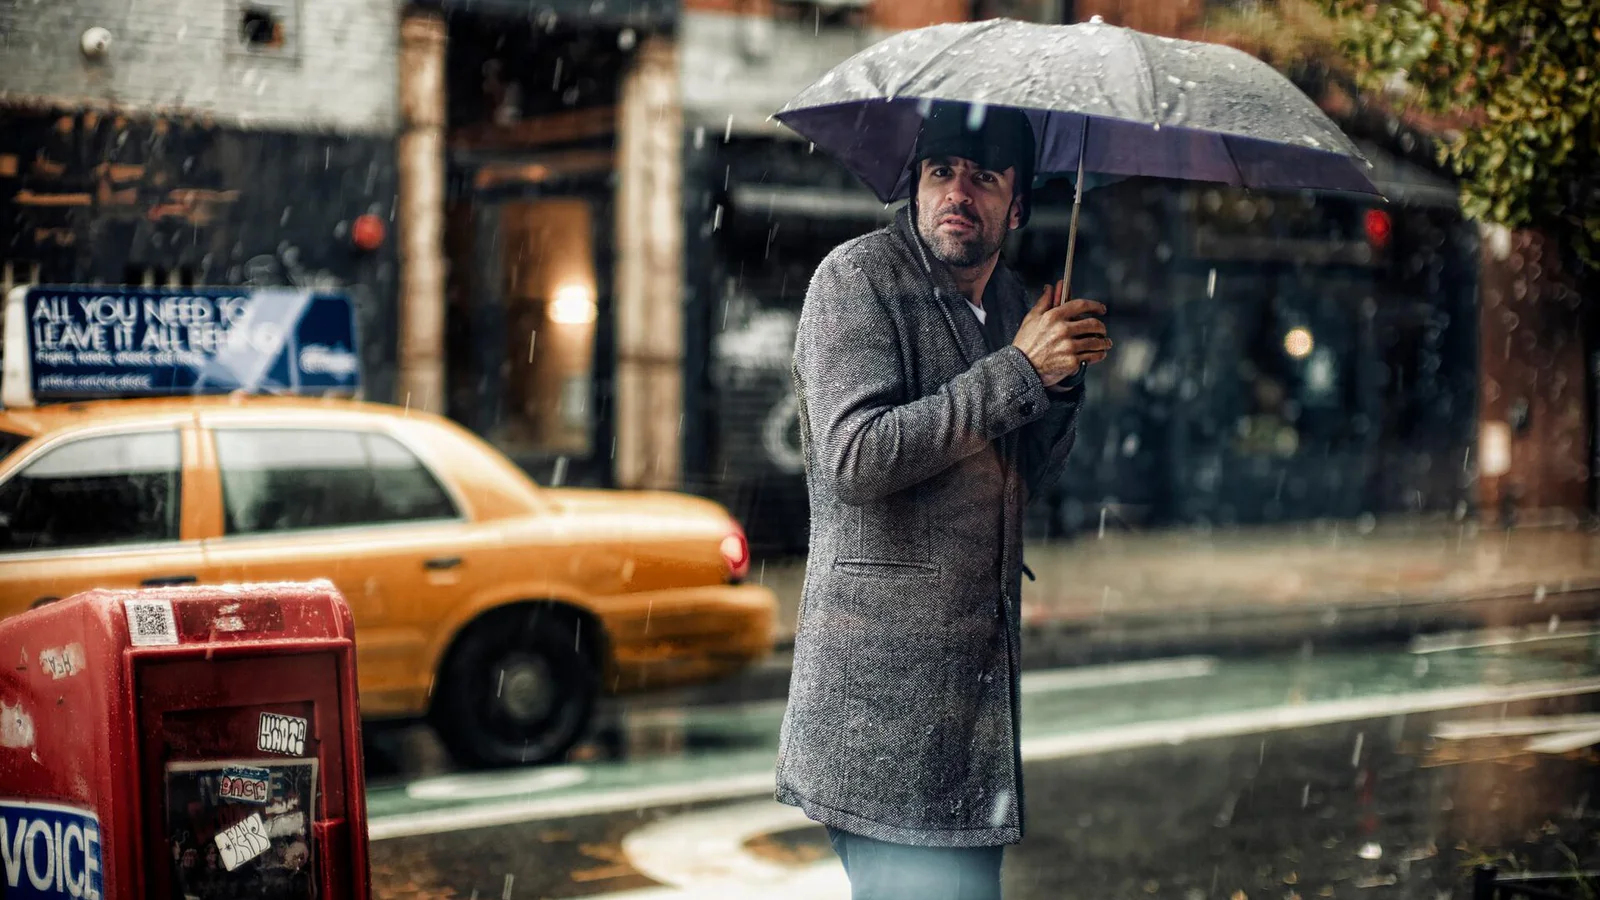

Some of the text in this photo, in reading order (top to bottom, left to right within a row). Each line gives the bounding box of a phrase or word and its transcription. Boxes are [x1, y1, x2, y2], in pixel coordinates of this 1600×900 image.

[33, 296, 249, 326] ALL YOU NEED TO
[34, 321, 107, 351] LEAVE
[113, 321, 135, 351] IT
[141, 322, 182, 352] ALL
[0, 816, 100, 900] VOICE
